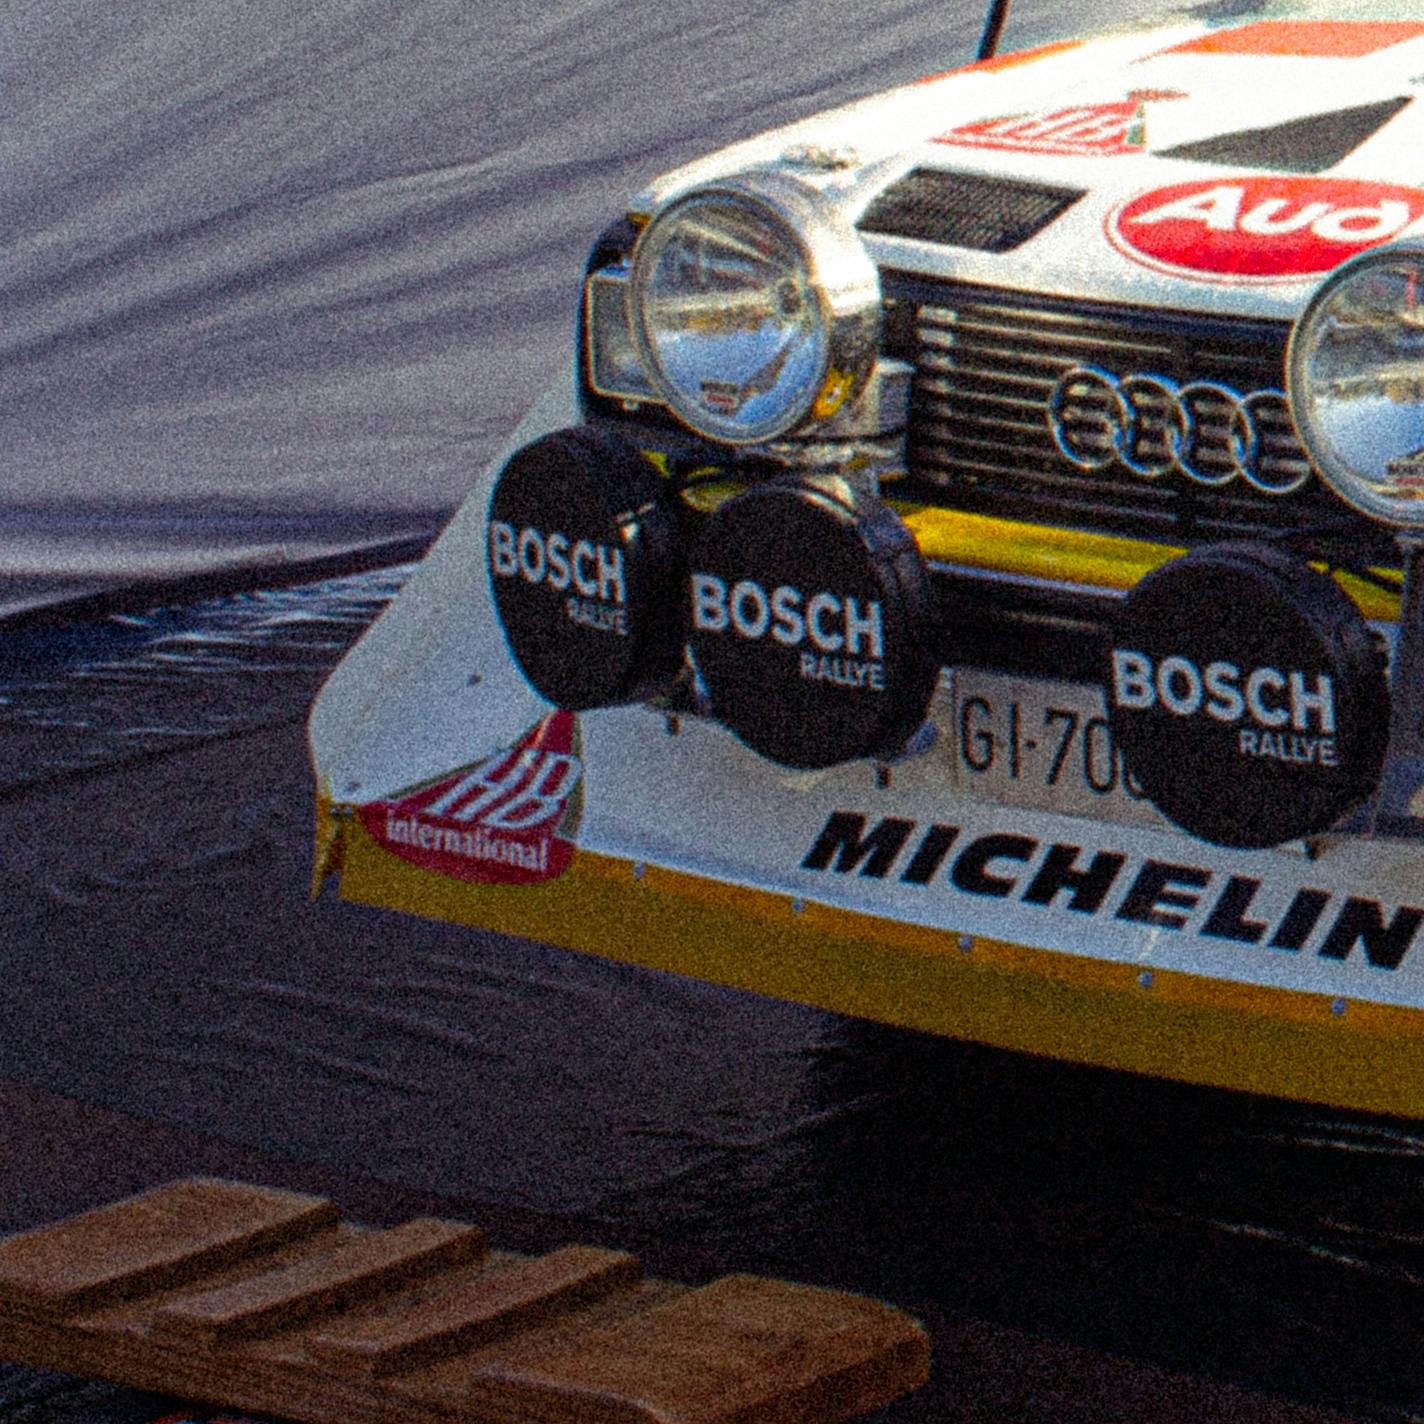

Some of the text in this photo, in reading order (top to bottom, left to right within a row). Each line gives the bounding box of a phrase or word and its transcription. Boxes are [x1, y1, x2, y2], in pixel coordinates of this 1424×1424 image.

[488, 520, 627, 603] BOSCH
[567, 596, 628, 636] RALLYE
[692, 573, 885, 658] BOSCH
[800, 654, 885, 691] RALLYE
[1113, 649, 1337, 734] BOSCH
[1238, 728, 1338, 767] RALLYE
[424, 749, 583, 830] HB
[387, 809, 549, 871] international
